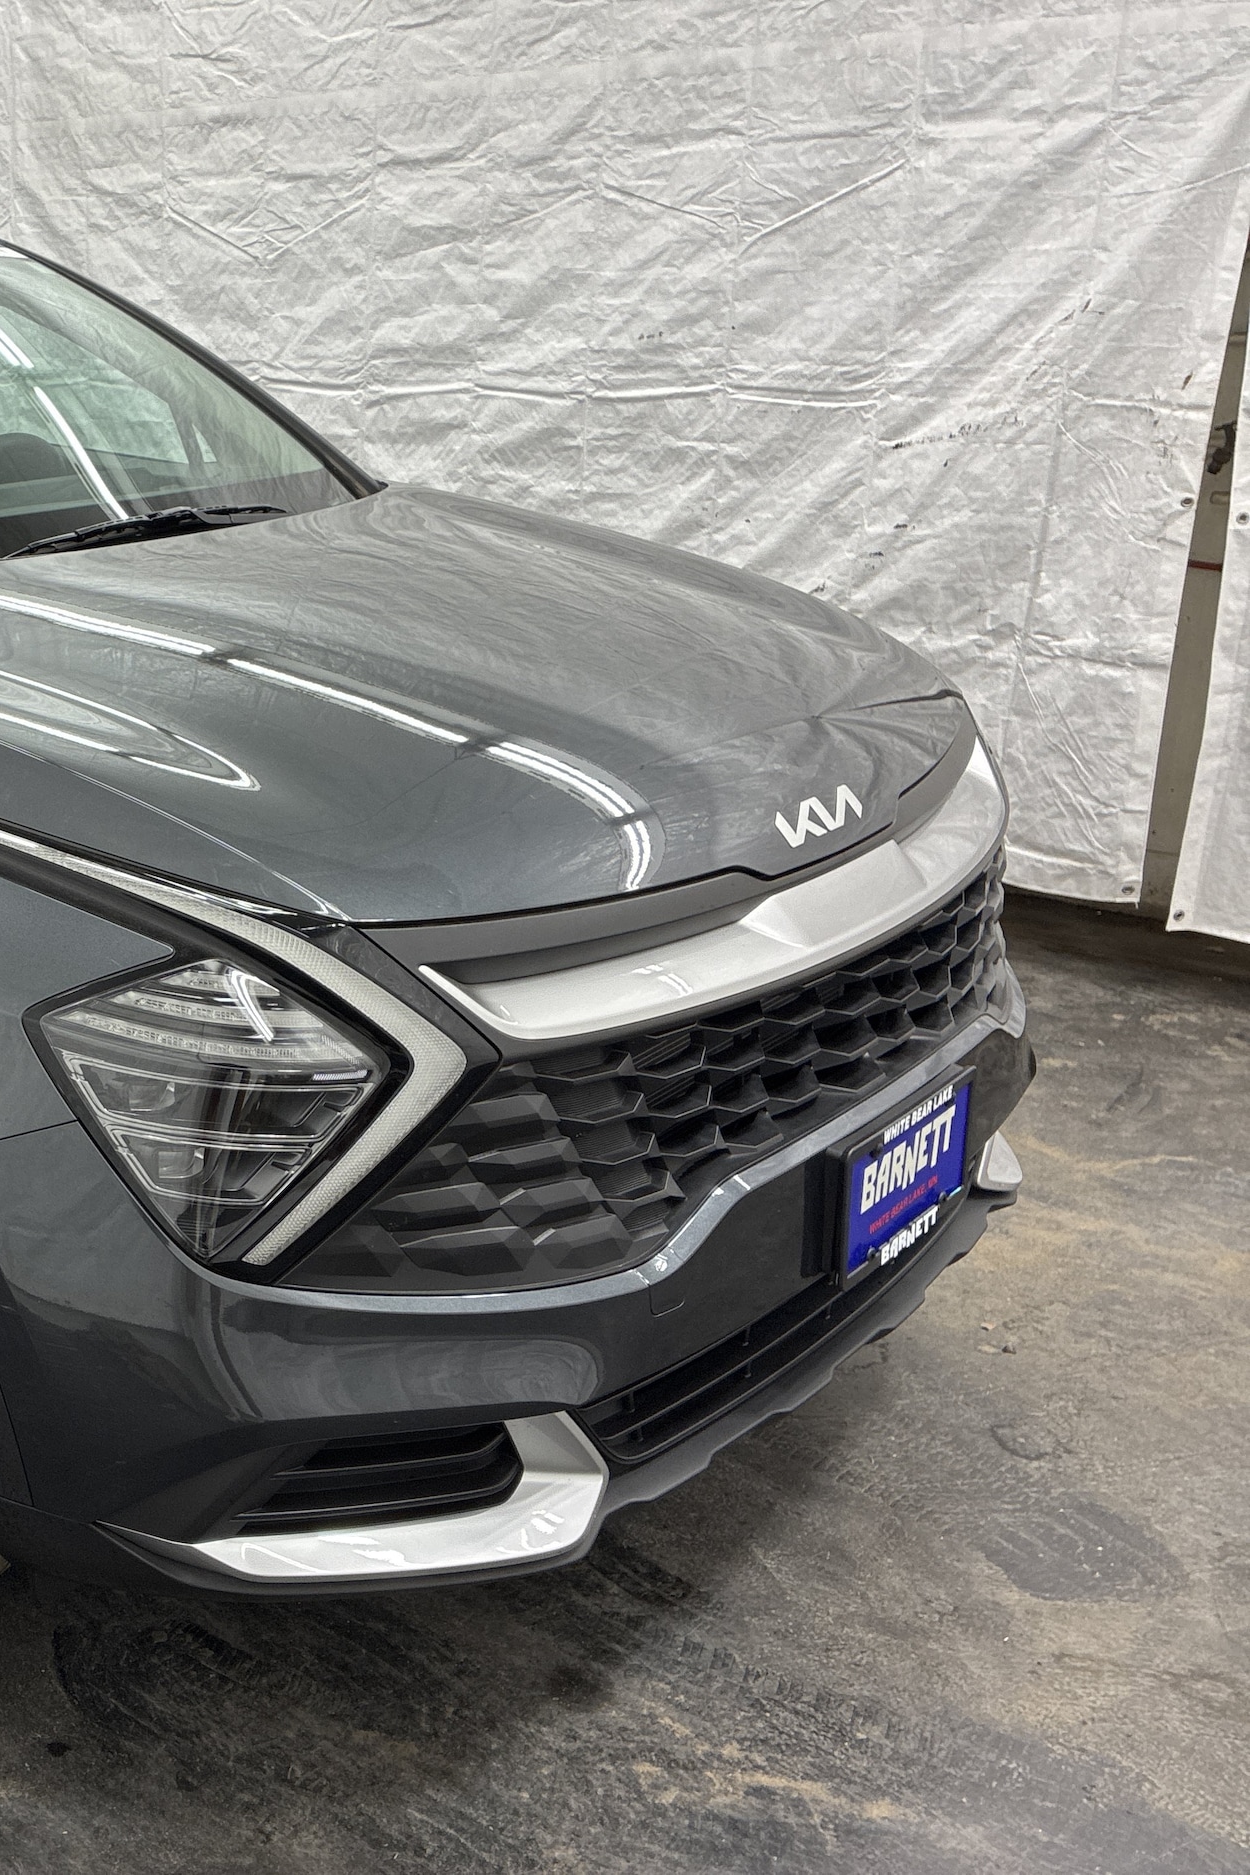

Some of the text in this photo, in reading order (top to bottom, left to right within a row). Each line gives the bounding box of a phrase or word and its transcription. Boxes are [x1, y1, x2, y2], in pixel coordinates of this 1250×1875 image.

[775, 784, 862, 848] KIA
[883, 1085, 954, 1145] WHITE BEAR LAKE
[860, 1104, 956, 1215] BARNETT
[869, 1211, 891, 1235] WHITE
[890, 1199, 908, 1219] BEAR
[880, 1206, 940, 1266] BARNETT
